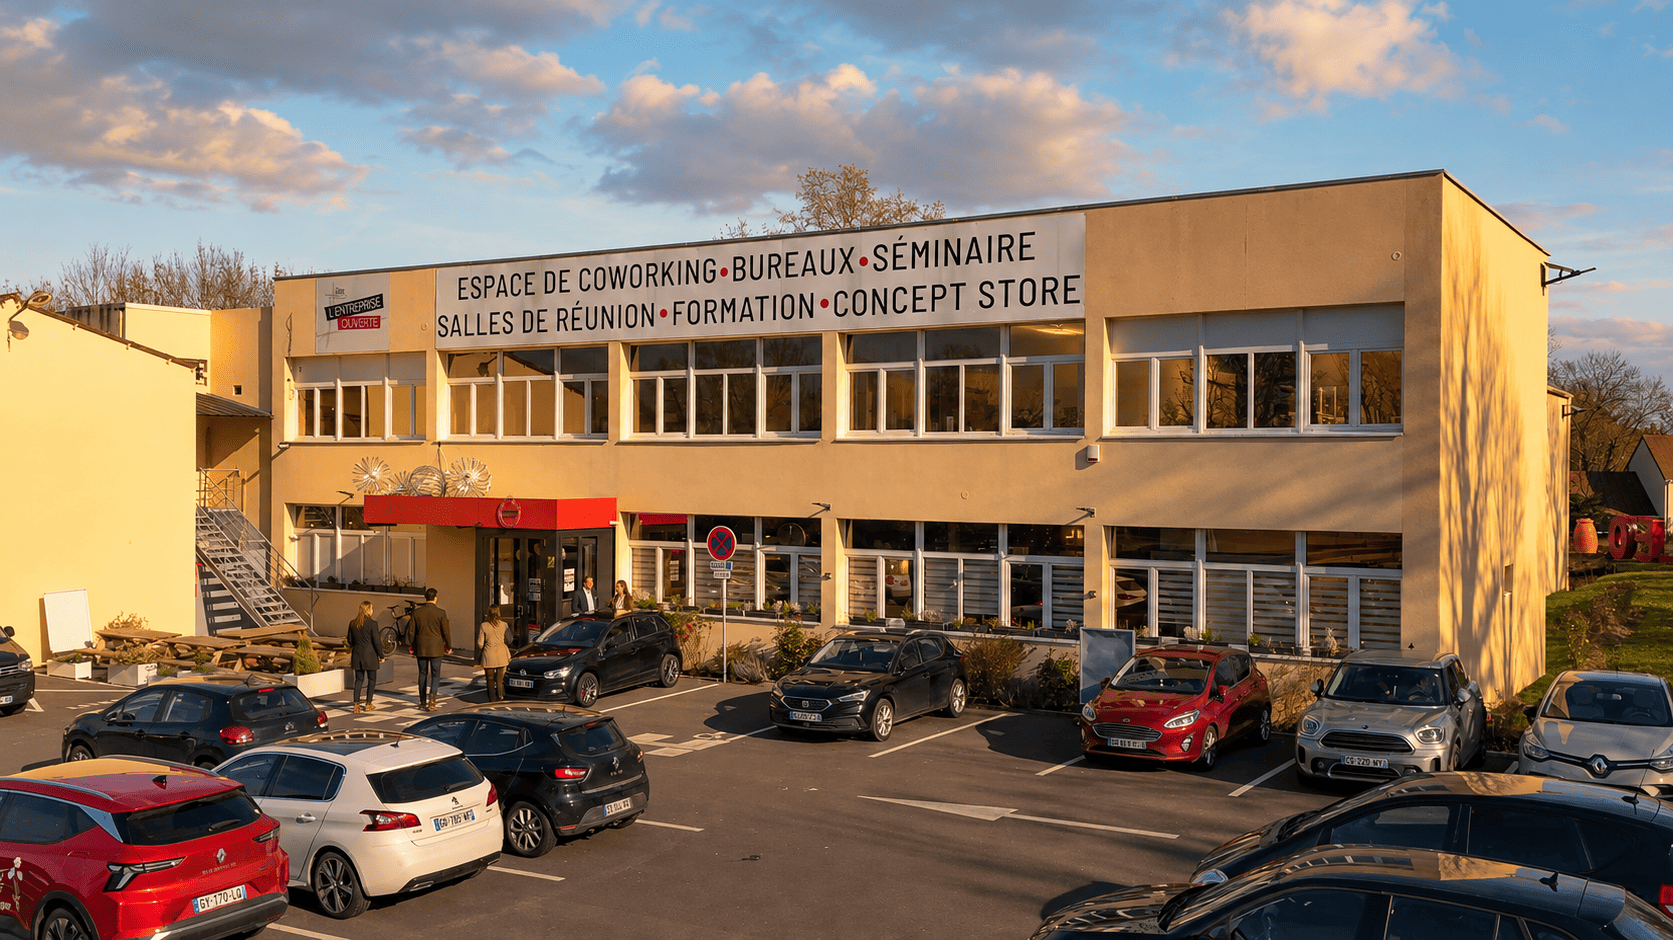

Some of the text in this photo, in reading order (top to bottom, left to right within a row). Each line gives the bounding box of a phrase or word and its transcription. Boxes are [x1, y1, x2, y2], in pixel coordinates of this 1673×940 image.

[457, 230, 1037, 302] ESPACE DE COWORKING BUREAUX SÉMINAIRE
[341, 317, 379, 329] OUVERTE
[437, 274, 1081, 338] SALLES DE RÉUNION FORMATION CONCEPT STORE
